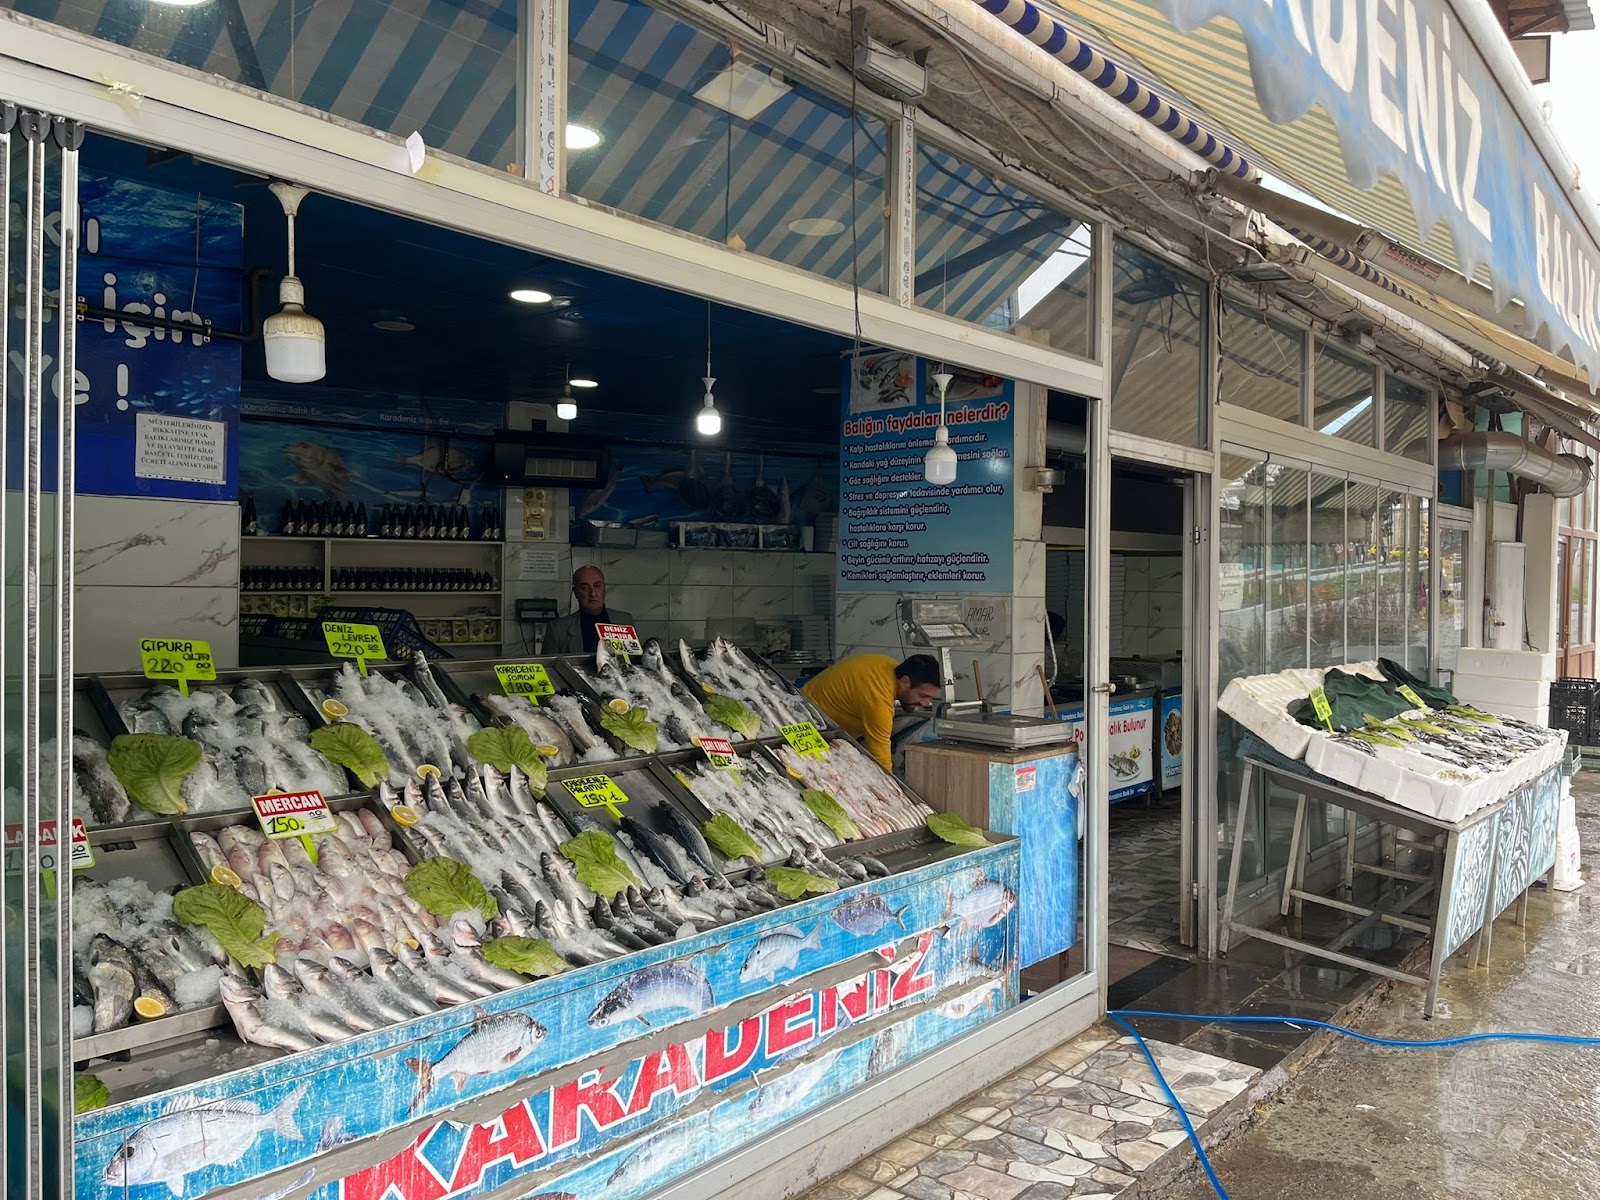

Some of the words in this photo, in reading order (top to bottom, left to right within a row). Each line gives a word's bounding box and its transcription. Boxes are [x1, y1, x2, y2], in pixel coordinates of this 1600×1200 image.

[379, 413, 418, 424] Karadeniz
[844, 418, 884, 438] Balığın
[886, 410, 943, 435] faydaları
[946, 402, 1010, 426] nelerdir?
[849, 444, 864, 455] Kalp
[907, 437, 938, 449] önlemey
[948, 432, 988, 445] ardımcıdır.
[849, 459, 875, 470] Kandaki
[875, 458, 889, 470] yağ
[889, 455, 922, 468] düzeyinin
[981, 448, 1009, 461] sağlar.
[849, 476, 862, 486] Göz
[862, 474, 890, 486] sağlığını
[890, 472, 924, 483] destekler.
[849, 492, 865, 501] Stres
[874, 490, 908, 502] depresyon
[909, 486, 950, 498] tedavisinde
[950, 484, 984, 496] yardımcı
[985, 483, 1004, 495] olur,
[848, 507, 879, 519] Bağışıklık
[879, 505, 909, 516] sistemini
[909, 503, 951, 517] güçlendirir,
[849, 523, 887, 532] hastalıklara
[887, 522, 905, 533] karşı
[905, 521, 926, 531] korur.
[847, 539, 859, 549] Cilt
[859, 539, 888, 550] sağlığını
[888, 538, 909, 548] korur.
[847, 555, 865, 566] Beyin
[866, 554, 891, 566] gücünü
[916, 552, 946, 565] hafızayı
[946, 552, 990, 565] güçlendirir.
[846, 571, 878, 581] Kemikleri
[878, 571, 927, 583] sağlamlaştırır,
[927, 570, 961, 581] eklemleri
[962, 571, 986, 581] korur.
[324, 623, 355, 634] DENİZ
[341, 633, 379, 643] LEVREK
[331, 642, 365, 656] 220
[1109, 720, 1122, 735] alık
[1123, 717, 1147, 733] Bulunur
[257, 793, 323, 814] MERCAN
[335, 930, 937, 1200] KARADENİZ
